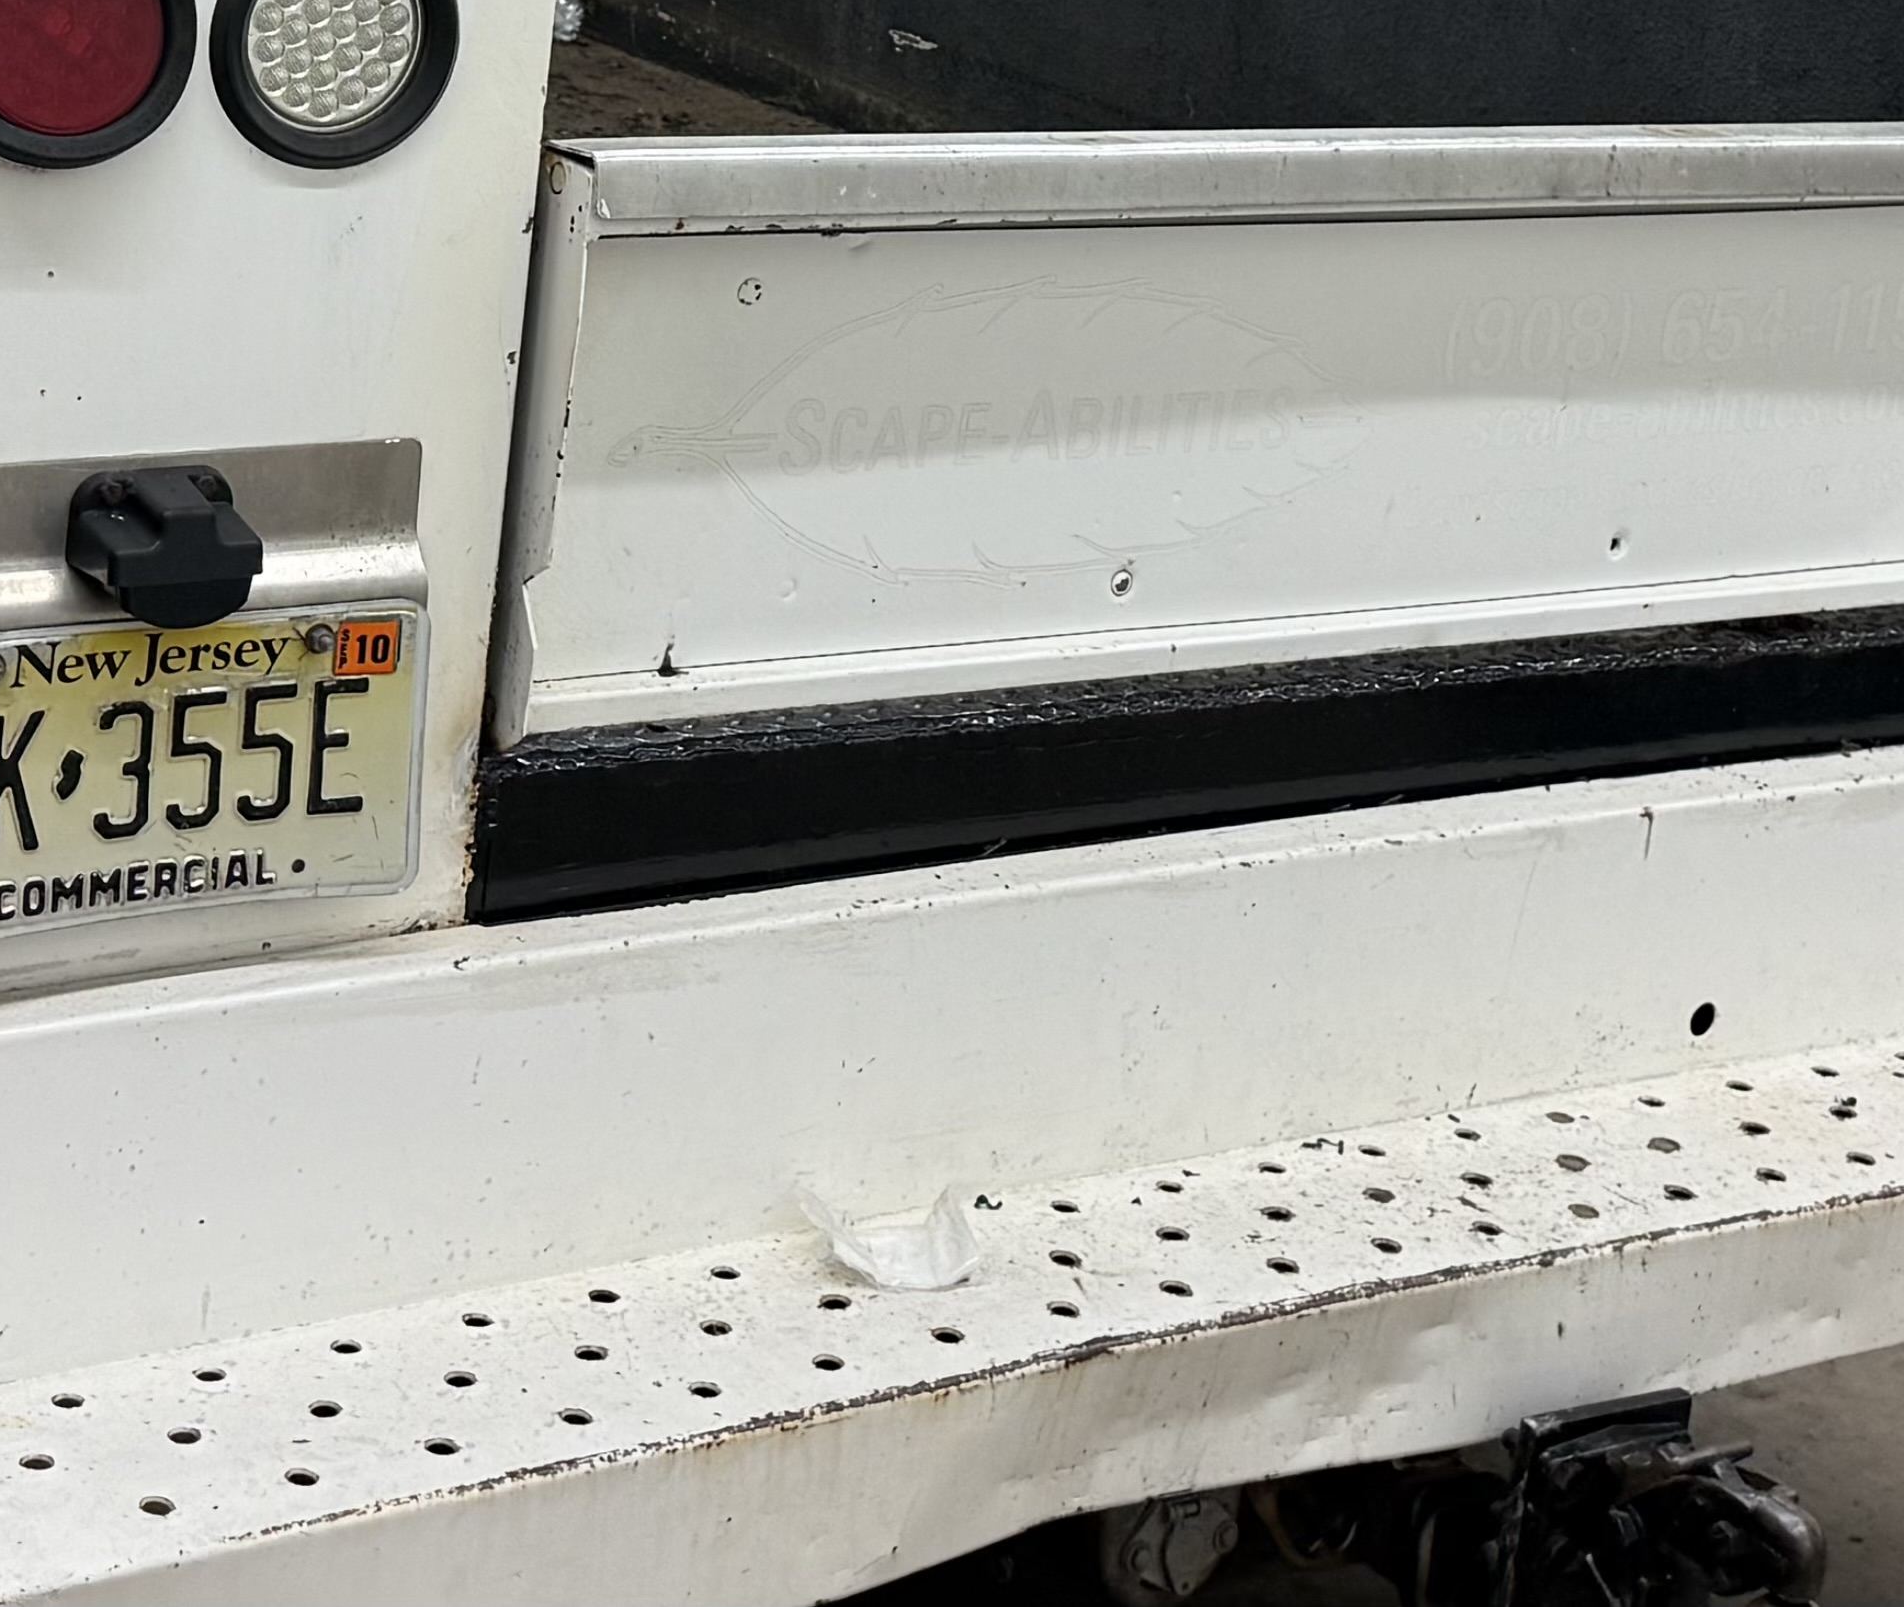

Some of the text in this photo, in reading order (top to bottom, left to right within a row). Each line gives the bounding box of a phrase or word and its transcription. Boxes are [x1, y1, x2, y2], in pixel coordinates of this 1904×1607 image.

[10, 632, 292, 689] New Jersey
[356, 634, 391, 665] 10
